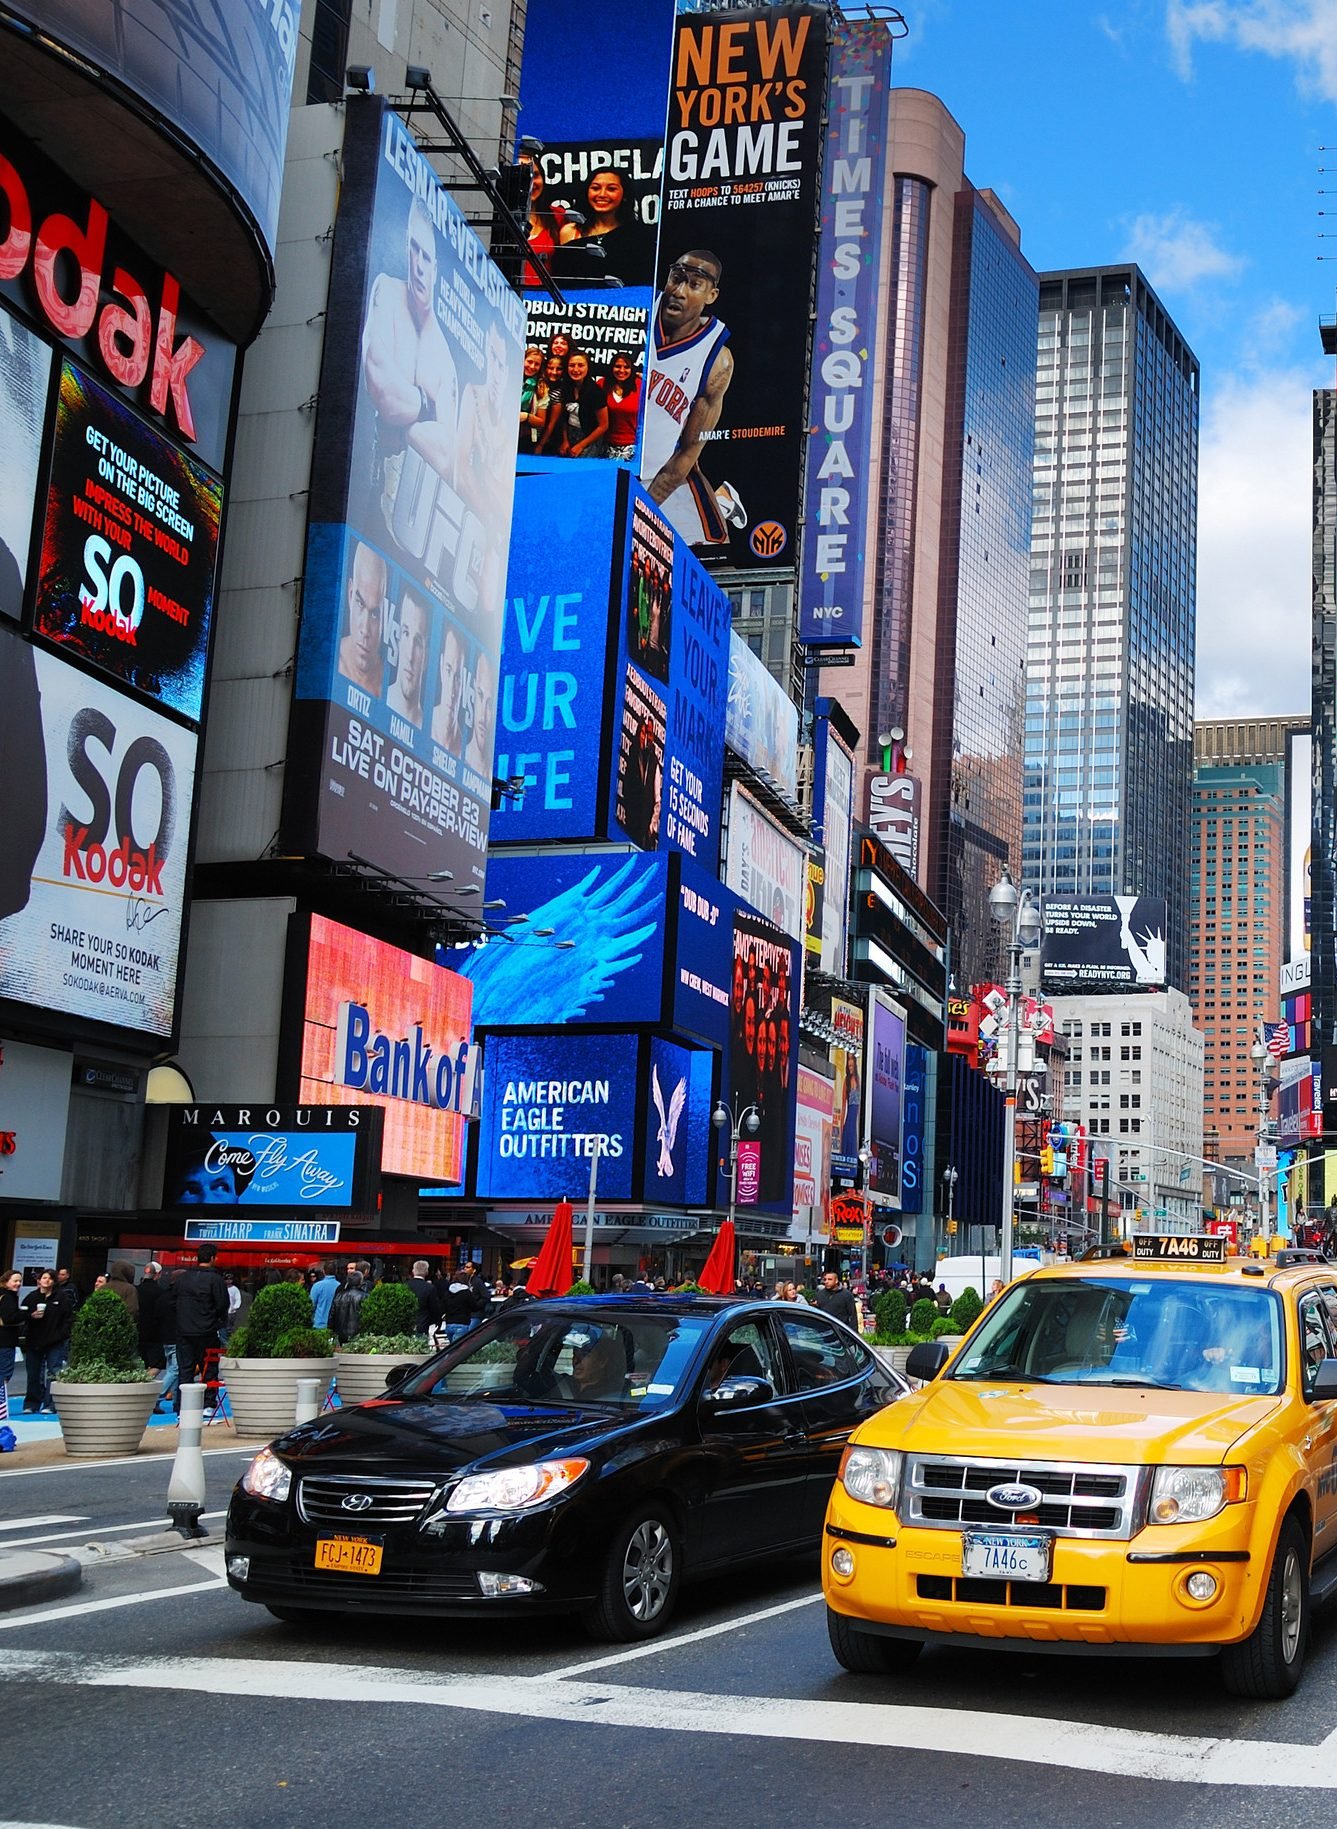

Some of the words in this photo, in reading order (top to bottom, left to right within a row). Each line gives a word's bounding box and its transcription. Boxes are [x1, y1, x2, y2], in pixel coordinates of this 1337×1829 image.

[676, 16, 811, 87] NEW
[676, 79, 807, 128] YORK'S
[670, 120, 804, 181] GAME
[668, 199, 685, 210] FOR
[686, 199, 693, 209] A
[694, 196, 729, 208] CHANCE
[730, 195, 741, 205] TO
[743, 193, 766, 204] MEET
[767, 190, 800, 202] AMAR'E
[669, 189, 689, 199] TEXT
[690, 186, 719, 197] HOOPS
[720, 185, 731, 196] TO
[733, 182, 764, 195] 564257
[765, 179, 801, 192] (KNICKS)
[832, 75, 875, 281] TIMES
[383, 113, 448, 240] LESNAR
[456, 222, 528, 350] VELASQUEZ
[439, 275, 485, 350] HEAVYWEIGHT
[452, 268, 477, 314] WORLD
[699, 429, 730, 441] AMAR'E
[731, 425, 786, 440] STOUDEMIRE
[815, 306, 862, 575] SQUARE
[85, 426, 110, 456] GET
[109, 441, 138, 479] YOUR
[138, 467, 180, 511] PICTURE
[98, 457, 114, 483] ON
[114, 467, 138, 500] THE
[137, 482, 156, 513] BIG
[155, 496, 194, 542] SCREEN
[73, 495, 103, 531] WITH
[103, 515, 132, 552] YOUR
[85, 478, 133, 526] IMPRESS
[133, 510, 154, 540] THE
[154, 526, 189, 567] WORLD
[392, 441, 483, 614] UFC
[78, 534, 145, 632] SO
[680, 557, 722, 649] LEAVE
[80, 595, 138, 647] Kodak
[147, 585, 190, 627] MOMENT
[812, 606, 844, 620] NYC
[384, 597, 401, 668] VS
[682, 624, 718, 706] YOUR
[347, 684, 371, 719] ORTIZ
[390, 713, 415, 751] HAMILL
[673, 685, 715, 763] MARK
[331, 736, 371, 778] LIVE
[373, 766, 398, 795] ON
[347, 719, 386, 763] SAT.
[390, 749, 460, 807] OCTOBER
[461, 798, 481, 826] 23
[669, 754, 684, 782] GET
[685, 767, 703, 805] YOUR
[57, 707, 178, 873] SO
[668, 784, 678, 808] 15
[678, 791, 710, 838] SECONDS
[666, 816, 677, 839] OF
[677, 826, 698, 858] FAME.
[63, 823, 167, 896] Kodak
[1045, 903, 1072, 911] BEFORE
[1079, 905, 1112, 913] DISASTER
[1045, 911, 1070, 919] TURNS
[1071, 920, 1098, 928] DOWN,
[50, 922, 86, 949] SHARE
[87, 931, 115, 958] YOUR
[115, 942, 128, 961] SO
[128, 942, 160, 972] KODAK
[1055, 927, 1080, 935] READY.
[62, 971, 147, 1006] SOKODAK@AERVA.COM
[71, 951, 115, 980] MOMENT
[116, 963, 141, 986] HERE
[1079, 970, 1131, 980] READYNYC.ORG
[335, 1000, 432, 1106] Bank
[431, 1037, 470, 1112] of
[502, 1080, 609, 1105] AMERICAN
[1313, 1075, 1322, 1110] Travelex
[182, 1109, 360, 1127] MARQUIS
[501, 1107, 564, 1131] EAGLE
[204, 1139, 253, 1174] Come
[237, 1134, 288, 1178] Fly
[284, 1149, 344, 1199] Away
[499, 1133, 624, 1158] OUTFITTERS
[741, 1162, 756, 1170] FREE
[218, 1222, 253, 1240] THARP
[284, 1223, 328, 1241] SINATRA
[604, 1214, 647, 1227] EAGLE
[648, 1215, 699, 1228] OUTFITTERS
[1136, 1248, 1154, 1256] DUTY
[1202, 1250, 1220, 1258] DUTY
[1138, 1238, 1153, 1246] OFF
[1158, 1237, 1199, 1256] 7A46
[1204, 1240, 1219, 1248] OFF
[1000, 1488, 1027, 1502] Ford
[350, 1535, 369, 1543] YORK
[905, 1550, 961, 1563] ESCAPE
